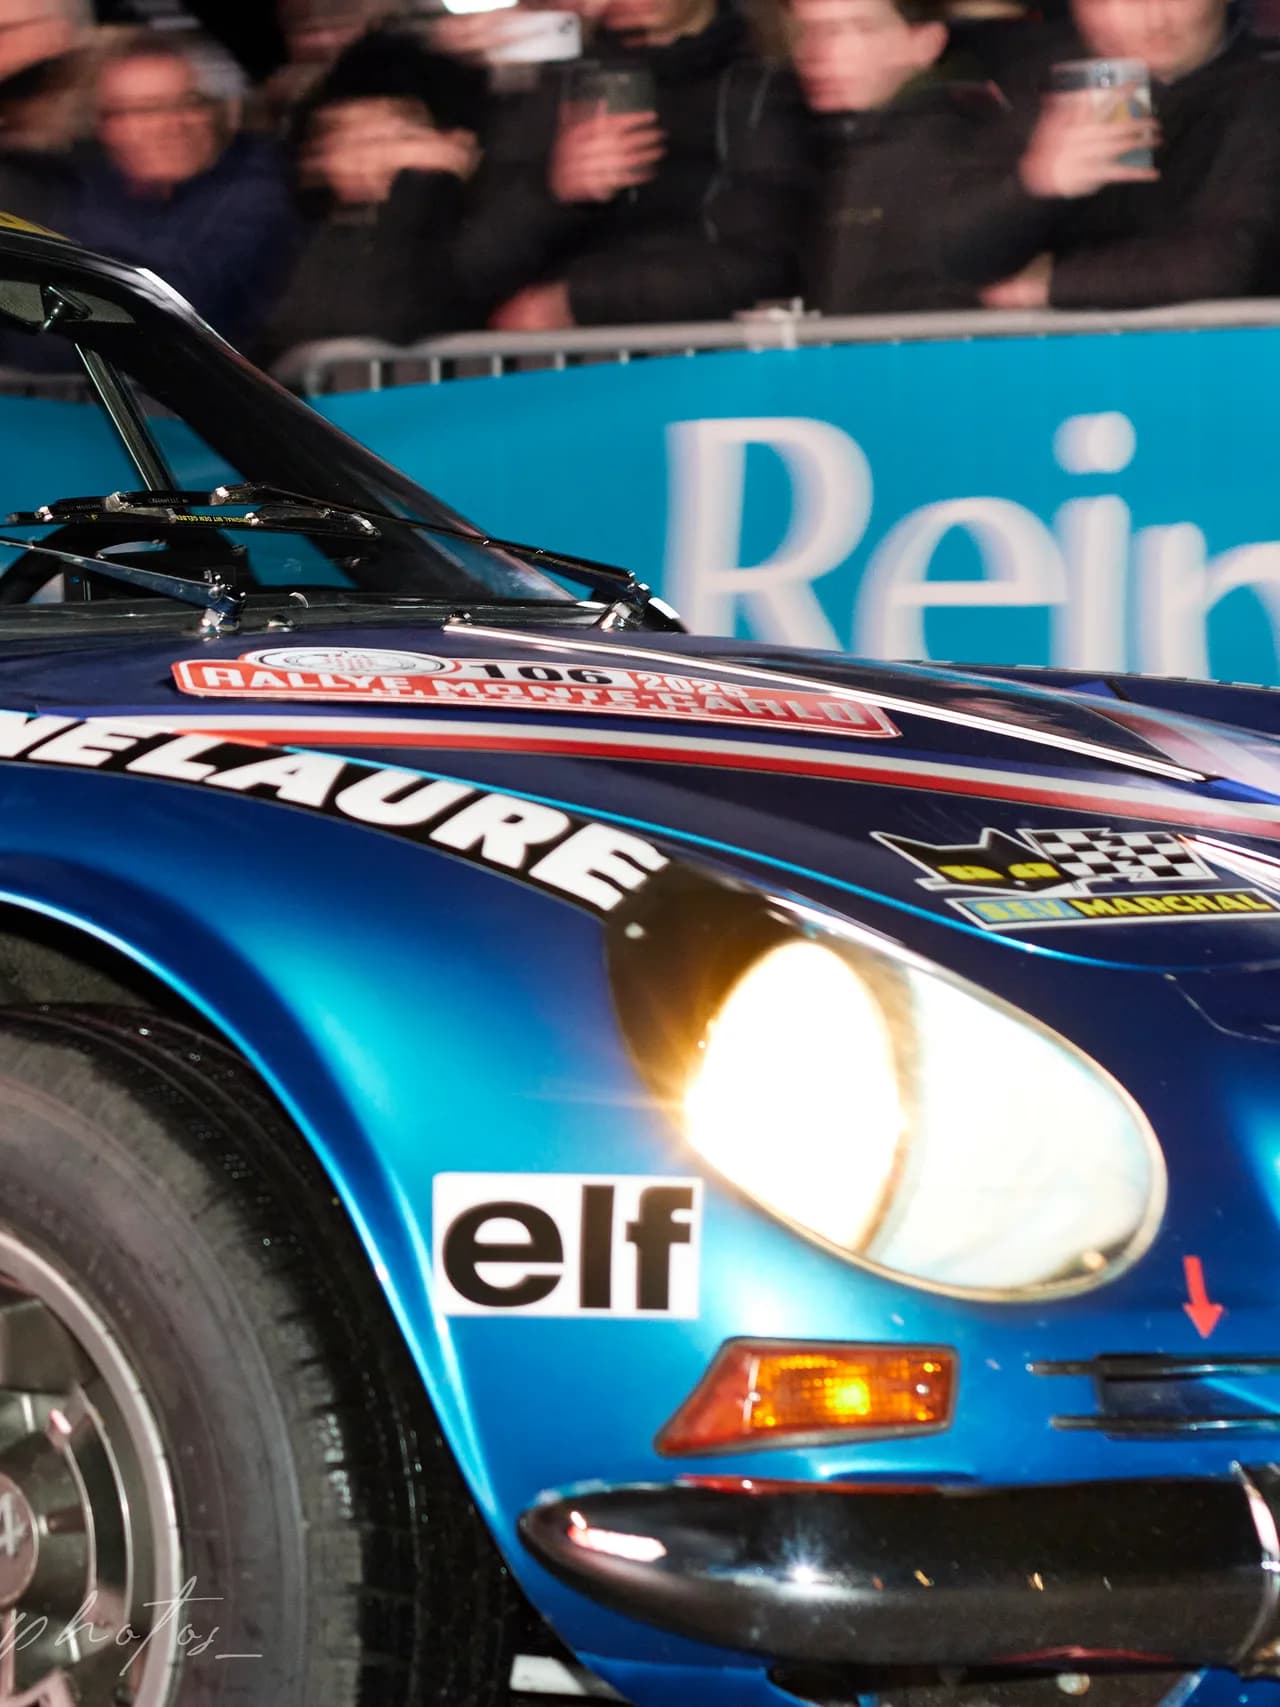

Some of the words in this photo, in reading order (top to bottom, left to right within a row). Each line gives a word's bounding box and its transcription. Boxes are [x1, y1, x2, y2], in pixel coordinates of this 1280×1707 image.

[469, 663, 615, 684] 106
[201, 666, 411, 690] RALLYE
[432, 679, 867, 724] MONTE-CARLO
[636, 674, 750, 698] 2025
[1070, 893, 1273, 917] MARCHAL
[442, 1185, 694, 1311] elf
